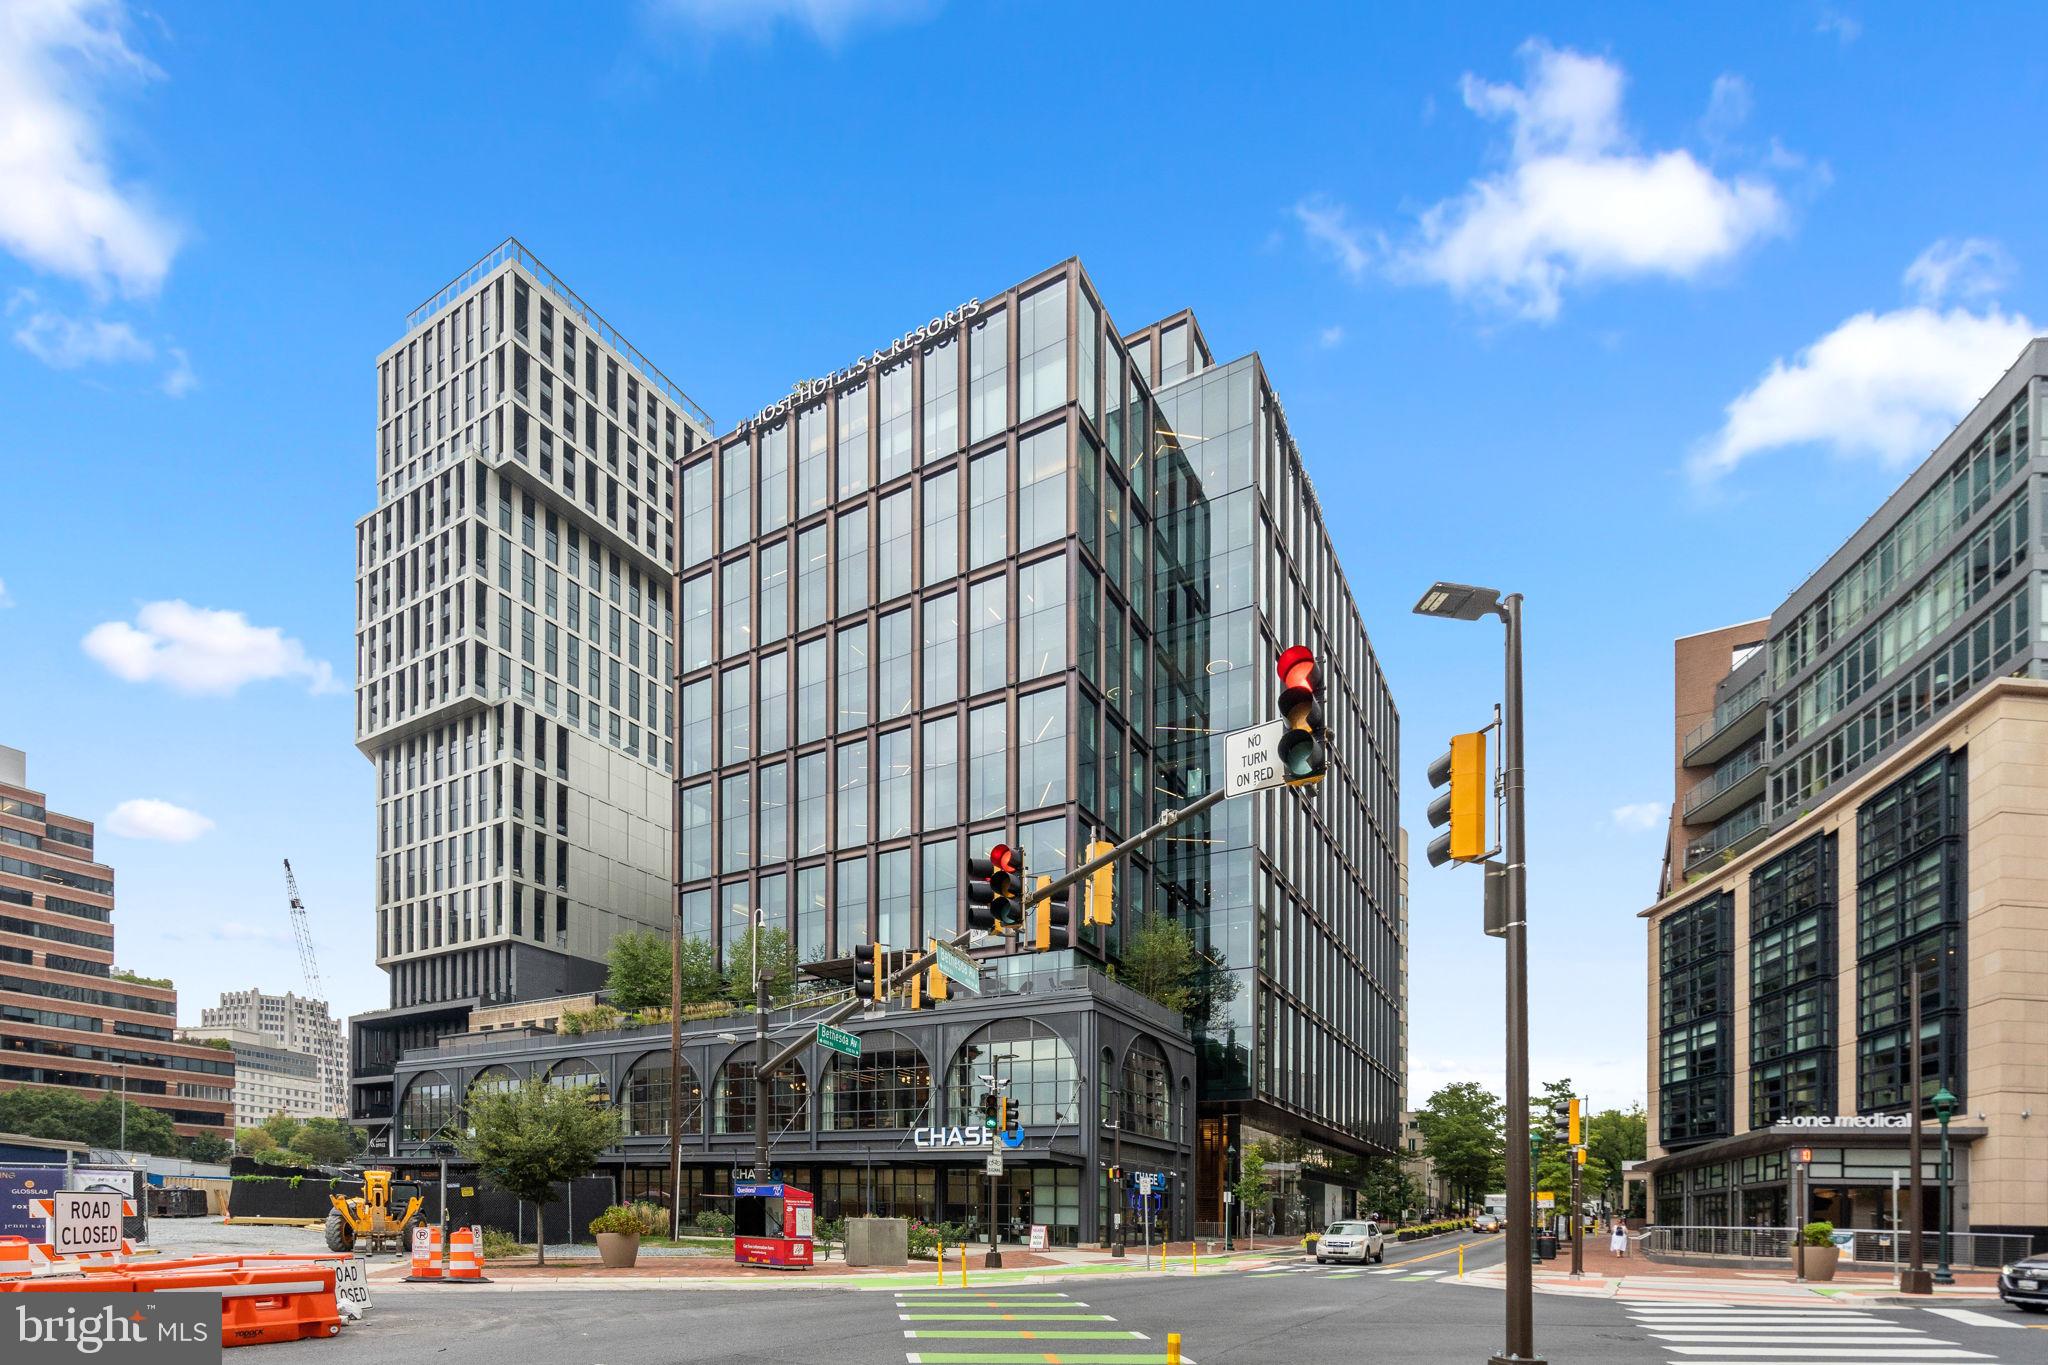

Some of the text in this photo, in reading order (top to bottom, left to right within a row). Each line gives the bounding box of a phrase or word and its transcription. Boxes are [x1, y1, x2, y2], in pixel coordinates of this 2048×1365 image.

[750, 393, 796, 429] HOST
[798, 355, 867, 404] HOTELS
[890, 297, 980, 356] RESORTS
[1247, 733, 1262, 748] NO
[1241, 750, 1268, 767] TURN
[1236, 766, 1274, 787] ON RED
[821, 1026, 849, 1045] Bethesda
[850, 1036, 858, 1048] Av
[1792, 1112, 1912, 1128] one medical
[914, 1126, 993, 1147] CHASE
[731, 1168, 771, 1180] CHA
[71, 1201, 111, 1219] ROAD
[61, 1225, 118, 1245] CLOSED
[335, 1265, 358, 1283] OAD
[339, 1286, 367, 1303] OSED
